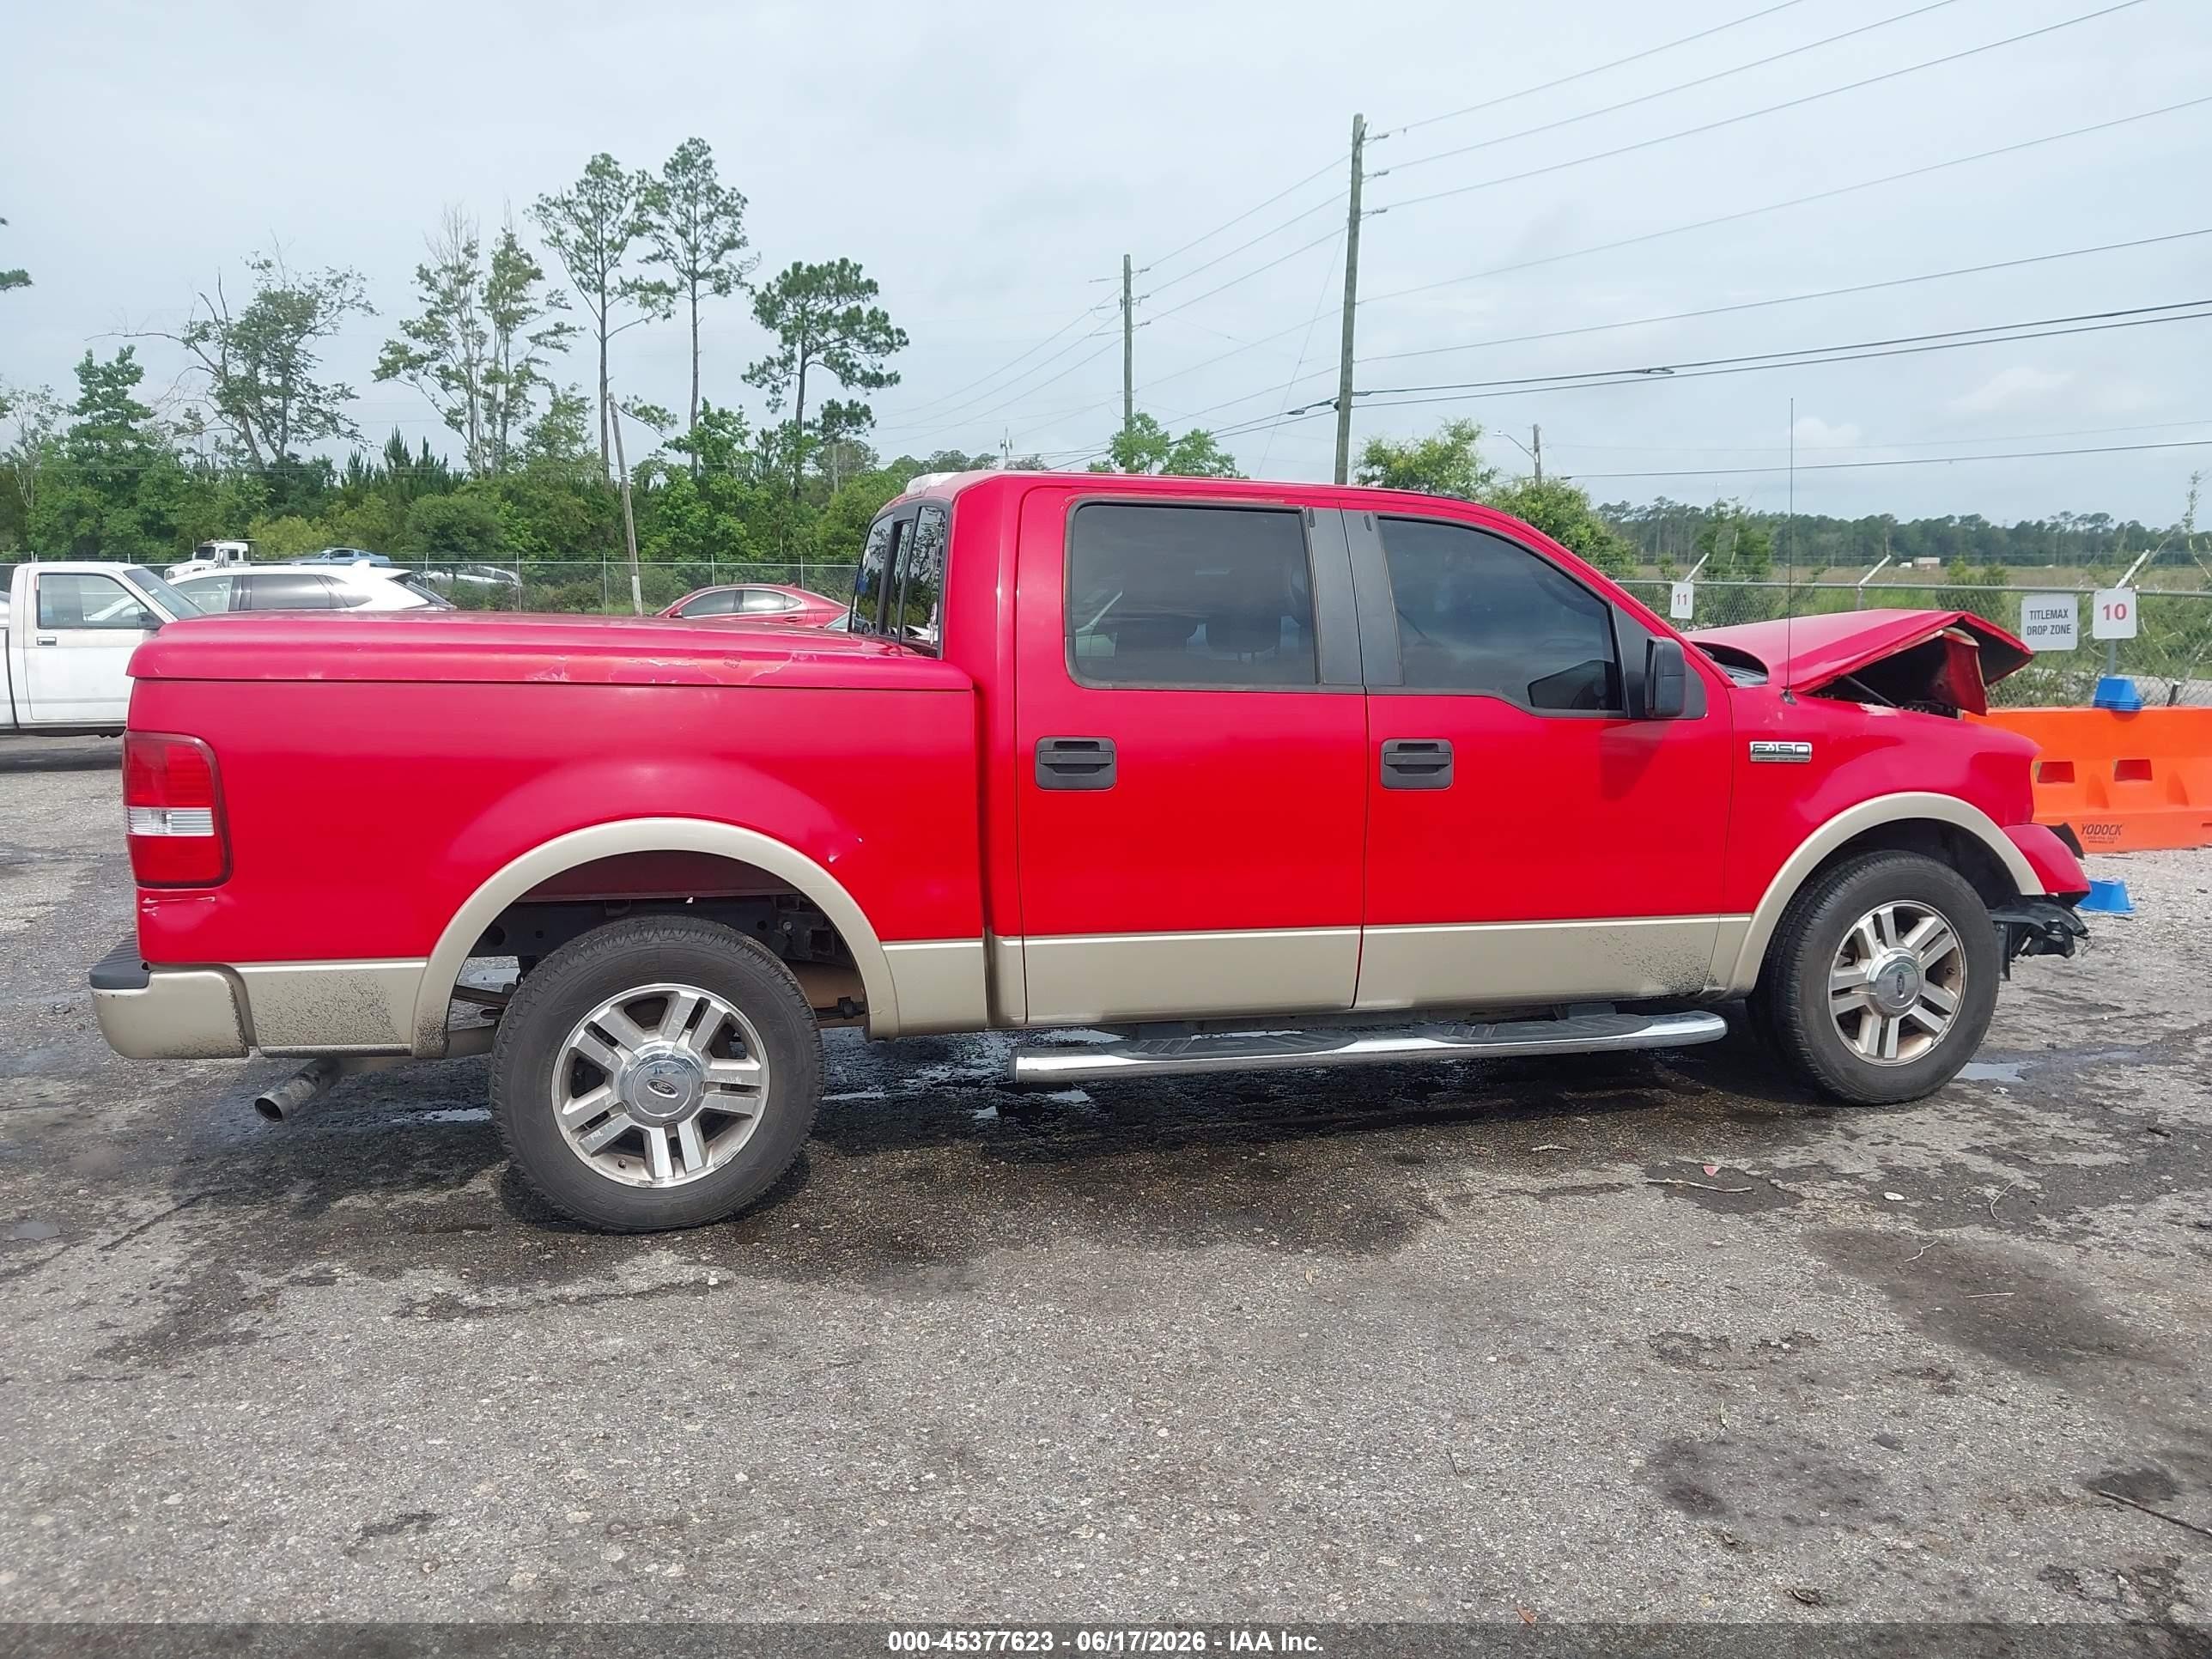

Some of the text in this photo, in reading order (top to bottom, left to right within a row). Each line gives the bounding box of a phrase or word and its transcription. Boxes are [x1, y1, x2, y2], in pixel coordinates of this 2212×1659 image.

[1676, 593, 1687, 605] 11
[2029, 609, 2069, 620] TITLEMAX
[2102, 603, 2127, 621] 10
[2027, 623, 2072, 635] DROP ZONE
[2081, 823, 2123, 836] YODOCK
